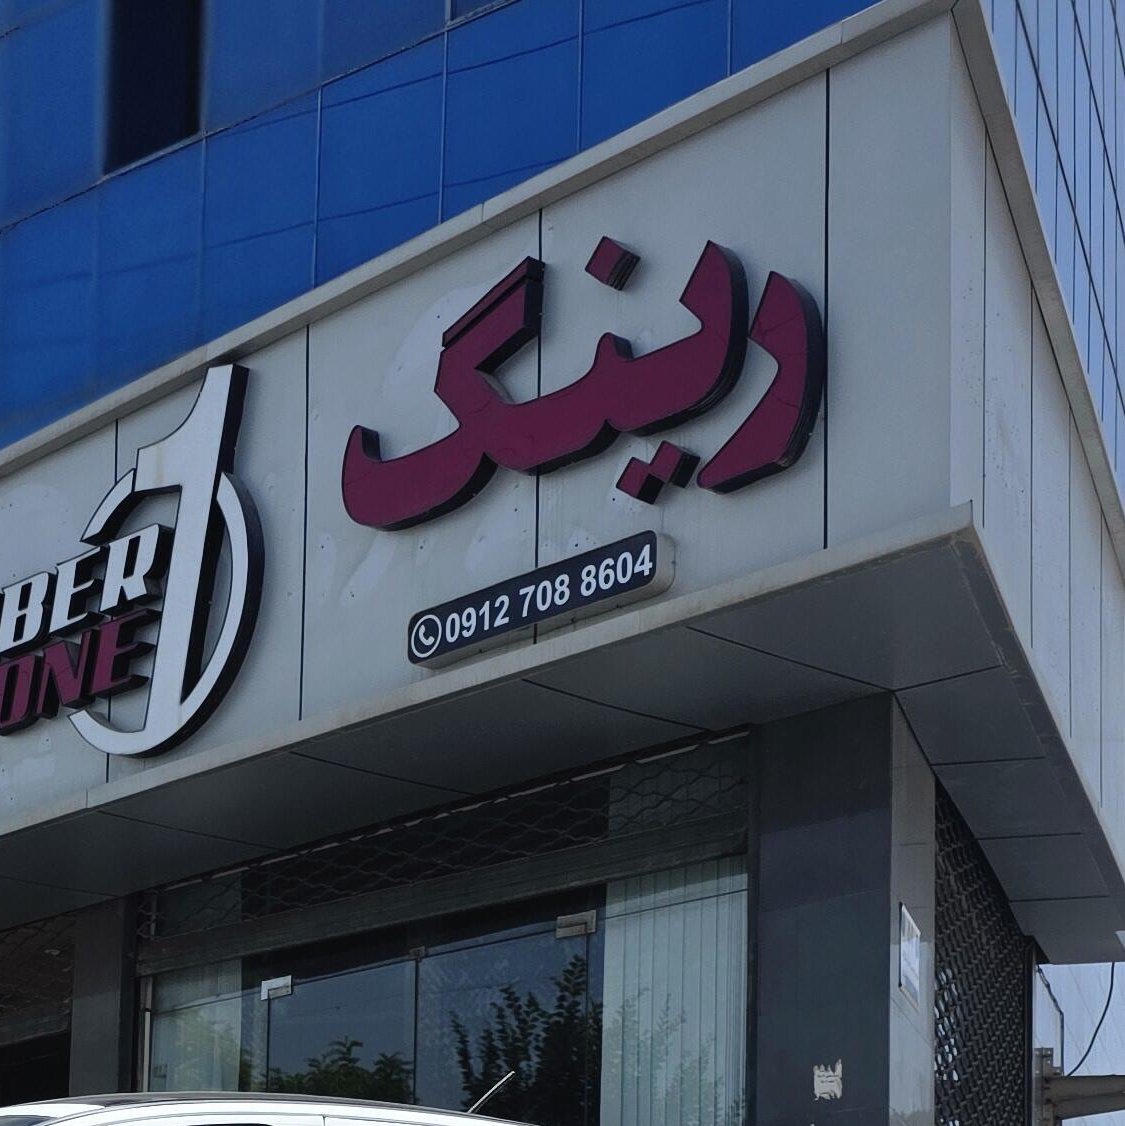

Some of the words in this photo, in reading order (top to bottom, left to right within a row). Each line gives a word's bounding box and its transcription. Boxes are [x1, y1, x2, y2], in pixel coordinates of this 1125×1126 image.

[342, 236, 824, 531] رینگ
[445, 595, 510, 643] 0912
[519, 573, 571, 618] 708
[580, 544, 653, 597] 8604
